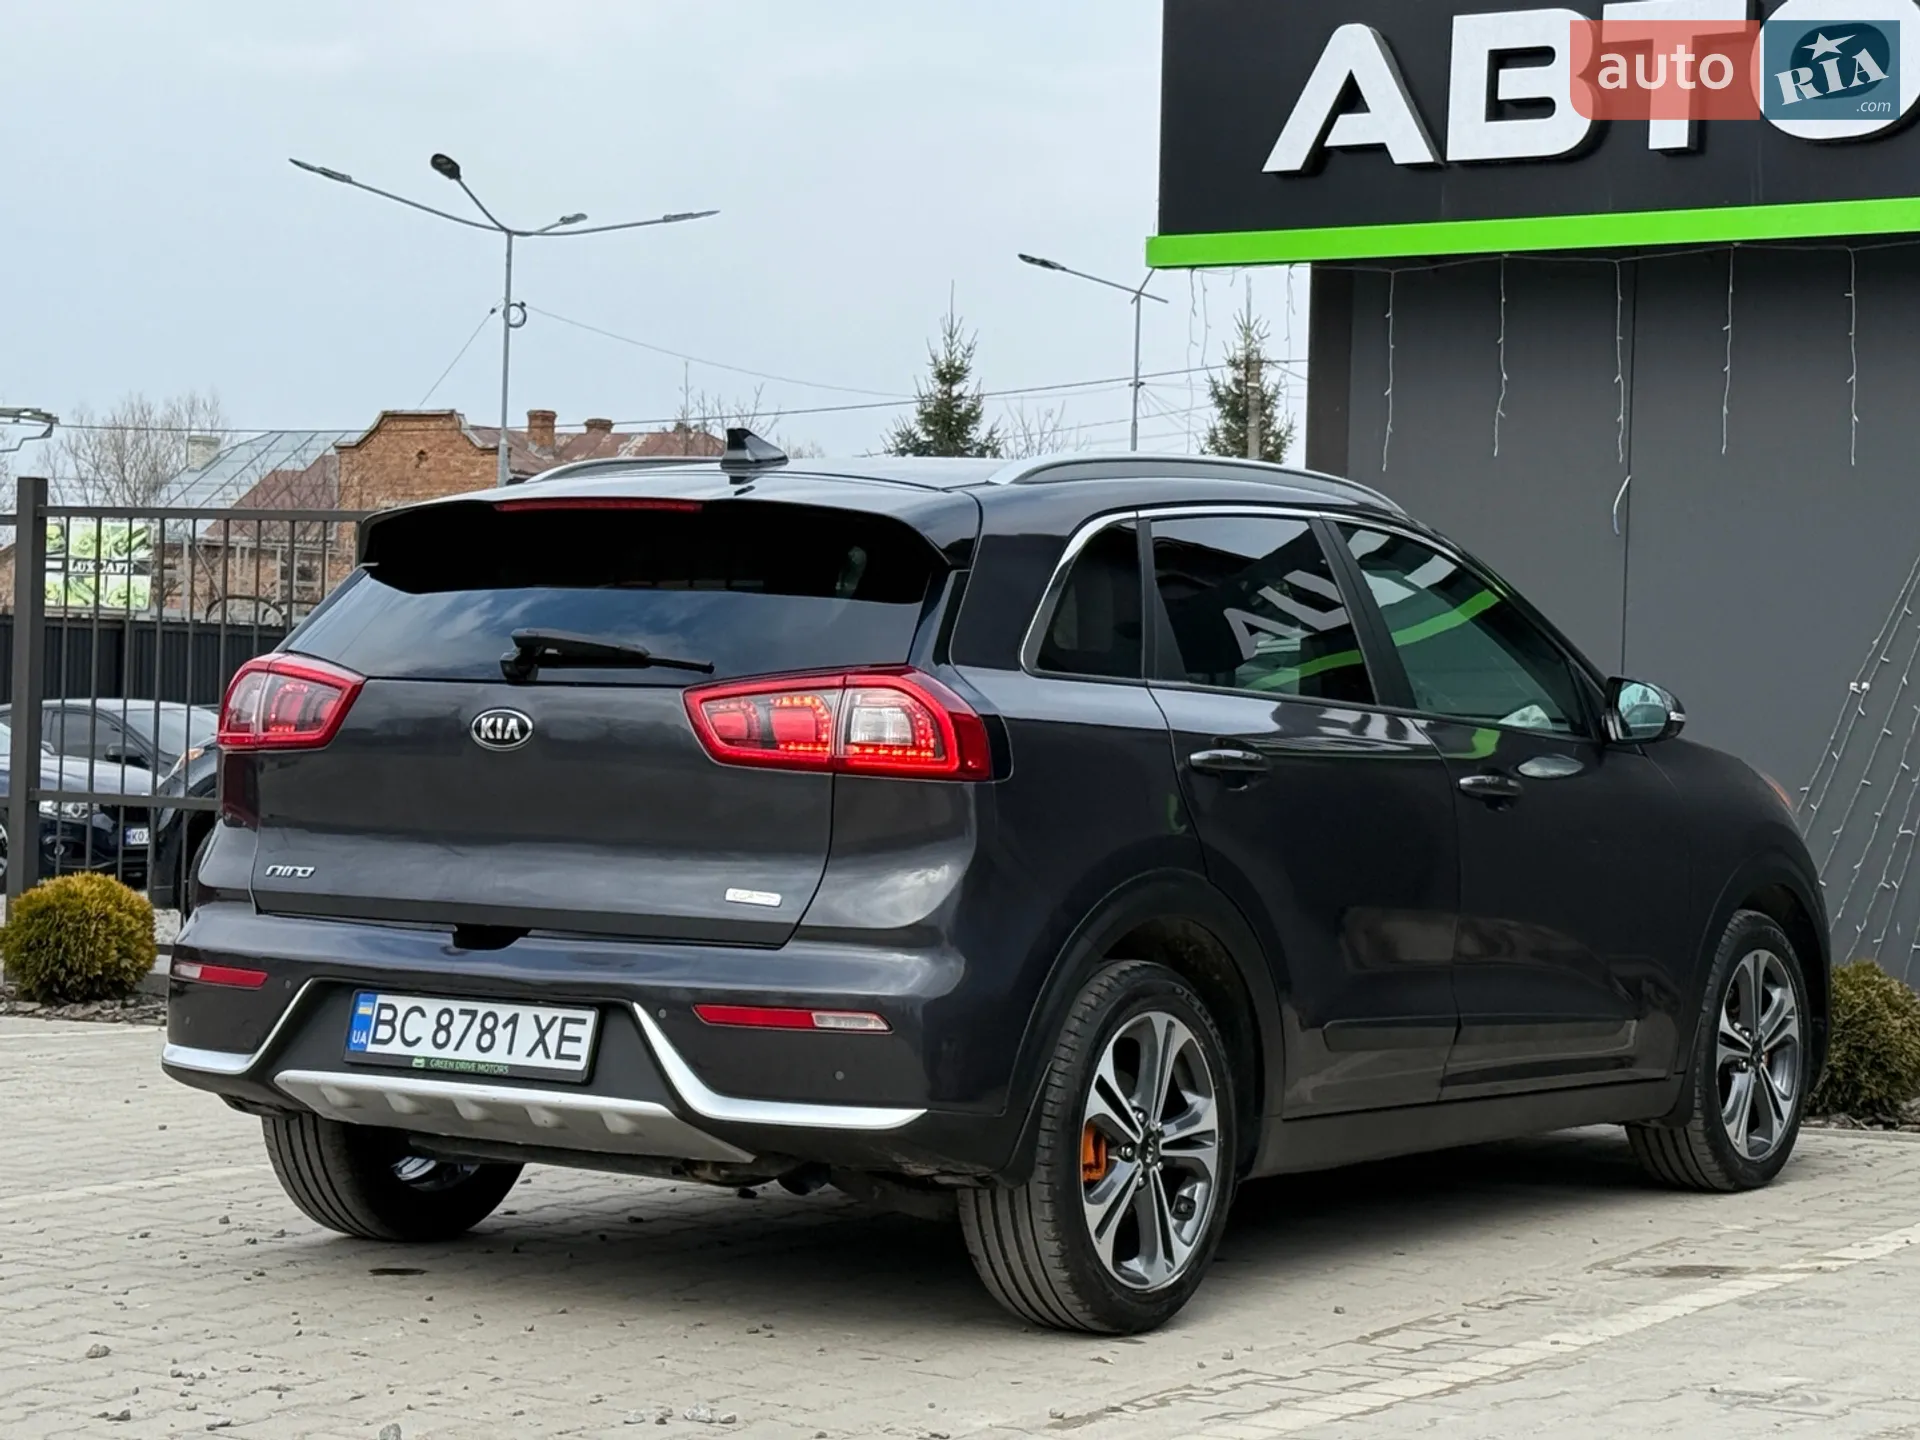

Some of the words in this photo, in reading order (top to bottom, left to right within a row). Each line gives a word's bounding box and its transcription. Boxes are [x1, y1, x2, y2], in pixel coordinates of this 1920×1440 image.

[68, 559, 96, 573] LUX
[481, 717, 521, 740] KIA
[352, 1030, 367, 1044] UA
[370, 1002, 427, 1048] BC
[431, 1007, 520, 1055] 8781
[525, 1013, 588, 1062] XE
[429, 1058, 455, 1069] GREEN
[455, 1061, 476, 1072] DRIVE
[477, 1063, 509, 1074] MOTORS
